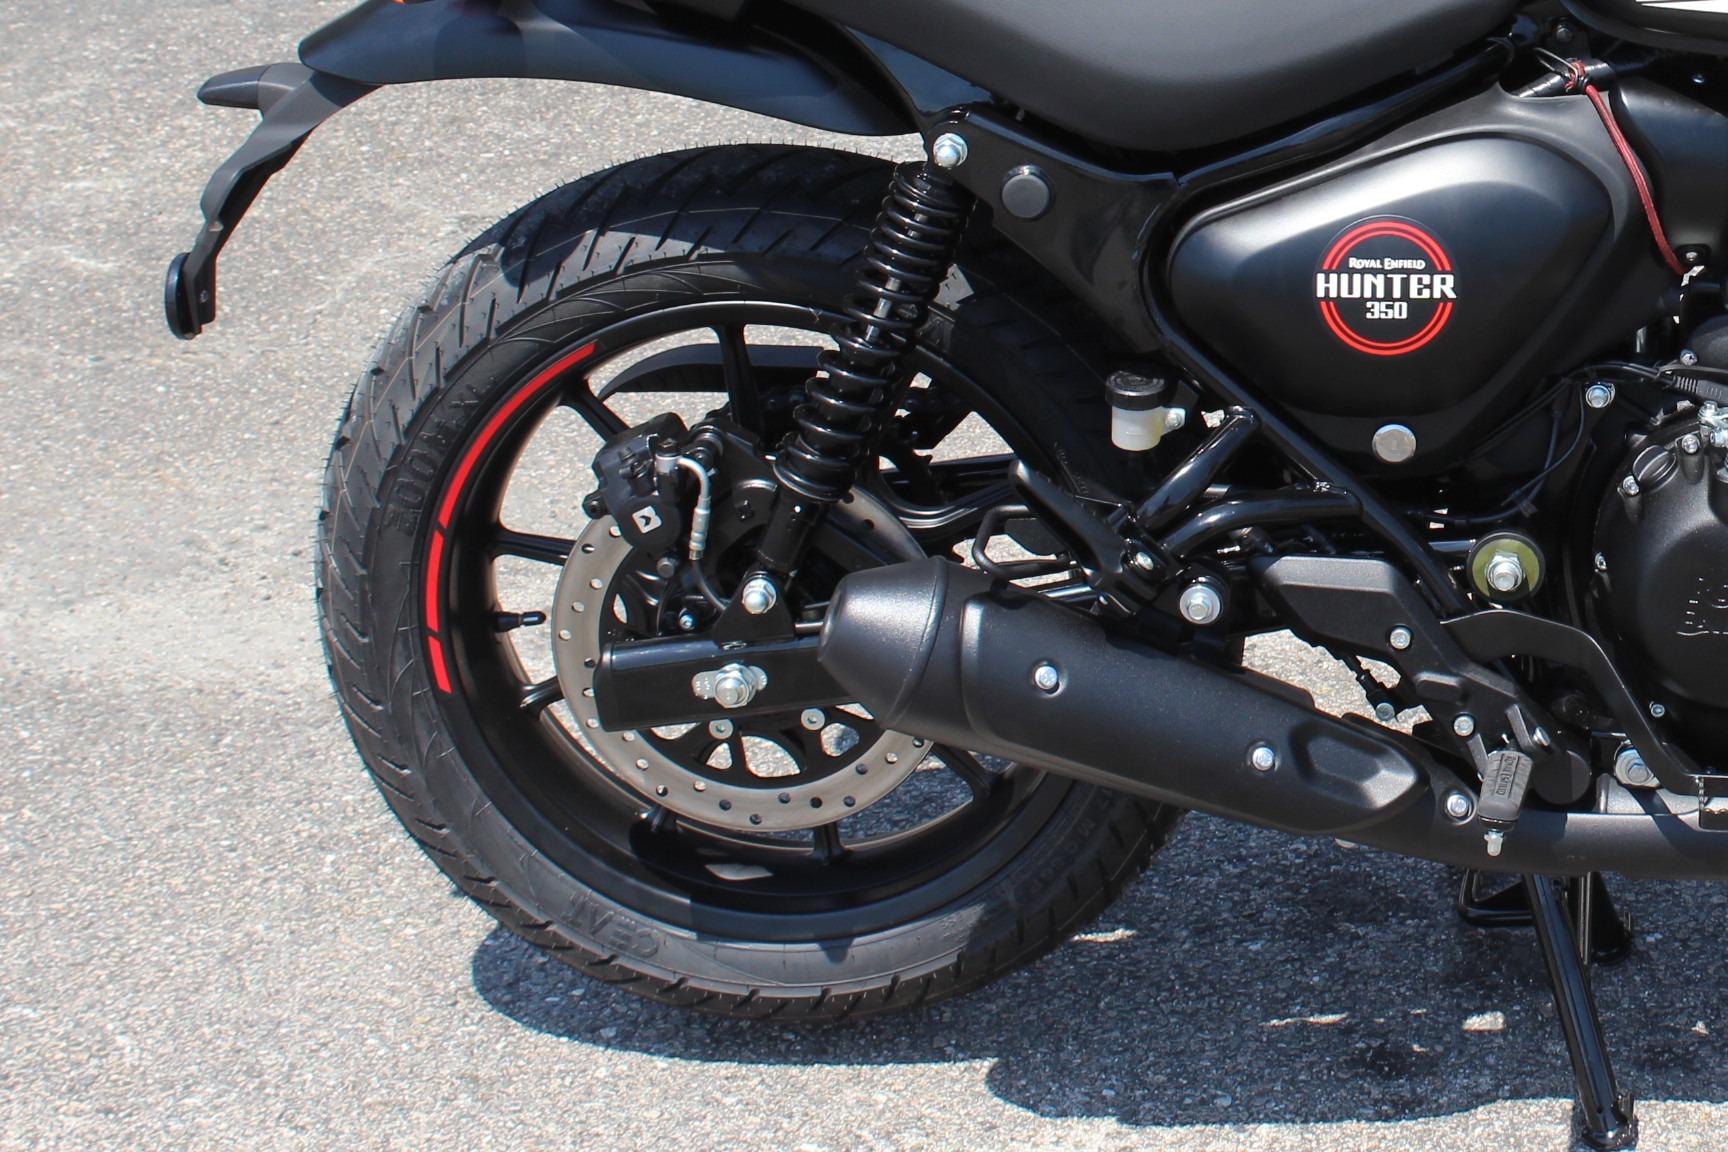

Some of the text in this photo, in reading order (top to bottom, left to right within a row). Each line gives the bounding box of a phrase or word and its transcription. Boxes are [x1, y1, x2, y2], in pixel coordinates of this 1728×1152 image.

[1348, 257, 1426, 270] ROYAL ENFIELD
[1316, 273, 1458, 299] HUNTER
[1365, 301, 1408, 319] 350
